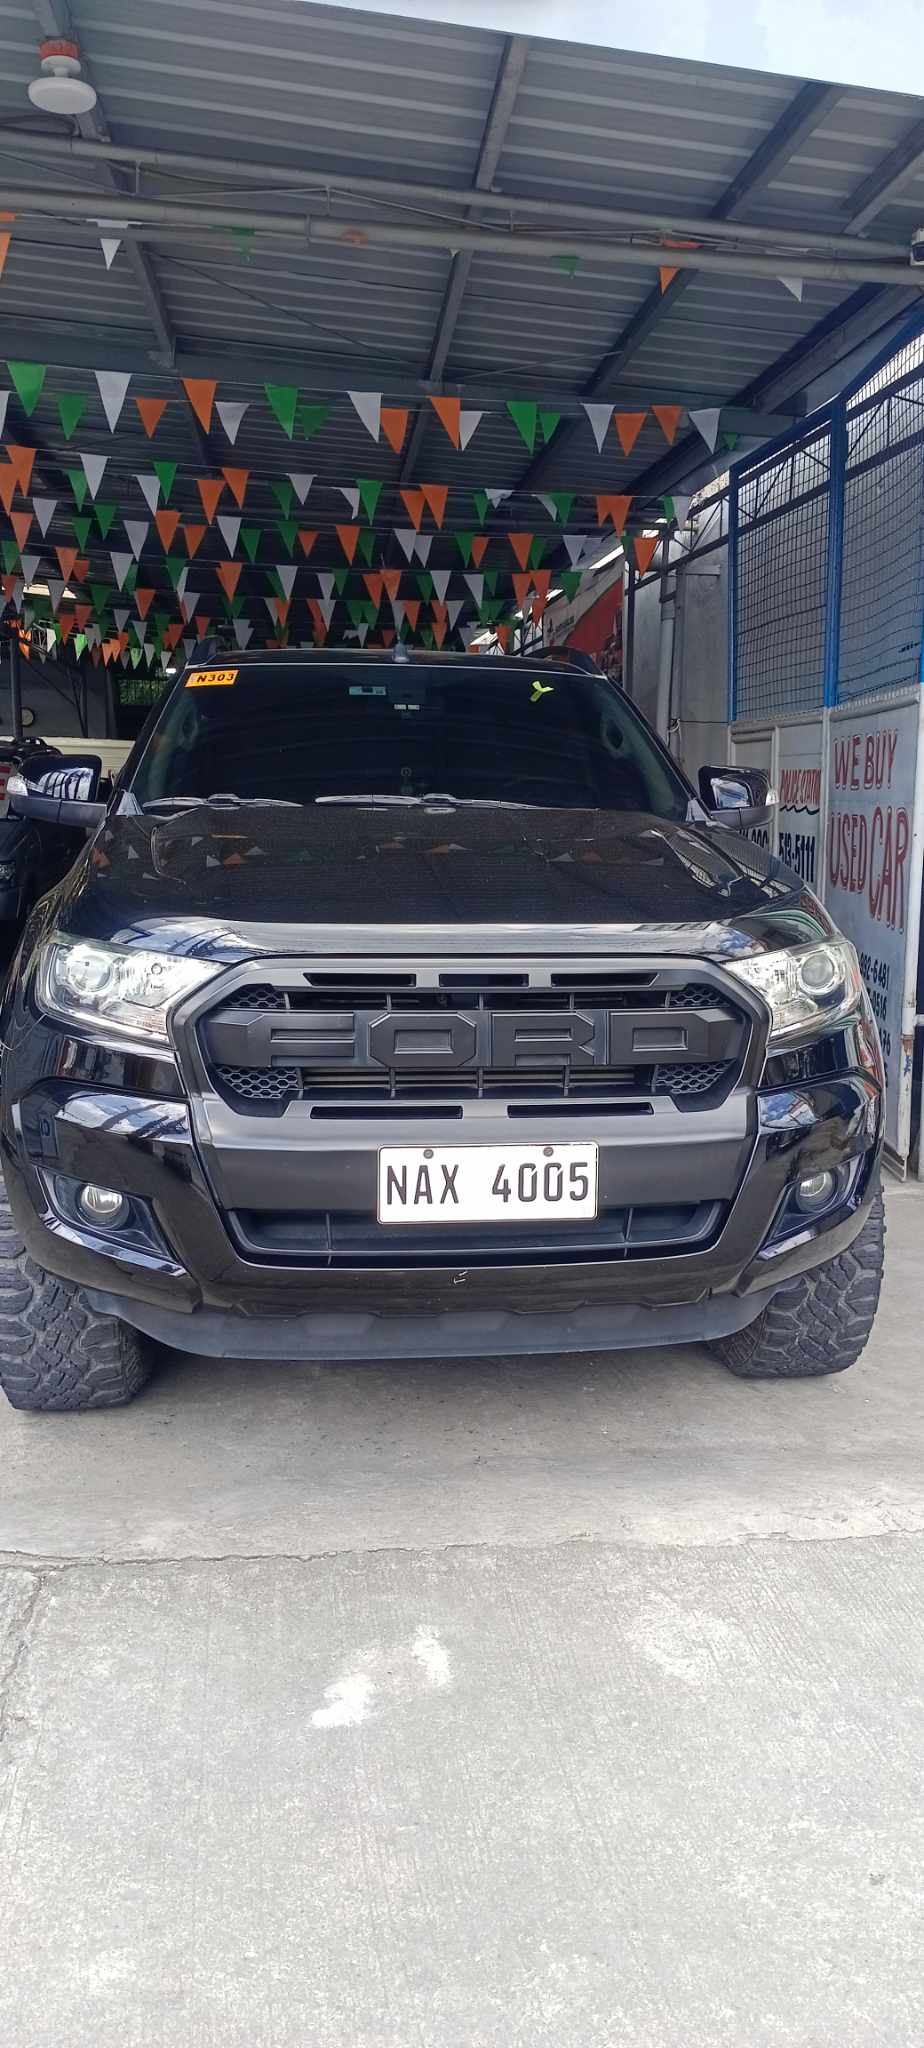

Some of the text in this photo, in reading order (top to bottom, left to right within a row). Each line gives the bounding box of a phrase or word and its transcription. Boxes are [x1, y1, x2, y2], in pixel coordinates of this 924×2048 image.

[833, 728, 898, 790] WE BUY
[828, 806, 909, 934] USED CAR
[198, 1009, 745, 1068] FORD
[387, 1162, 588, 1205] NAX 4005
